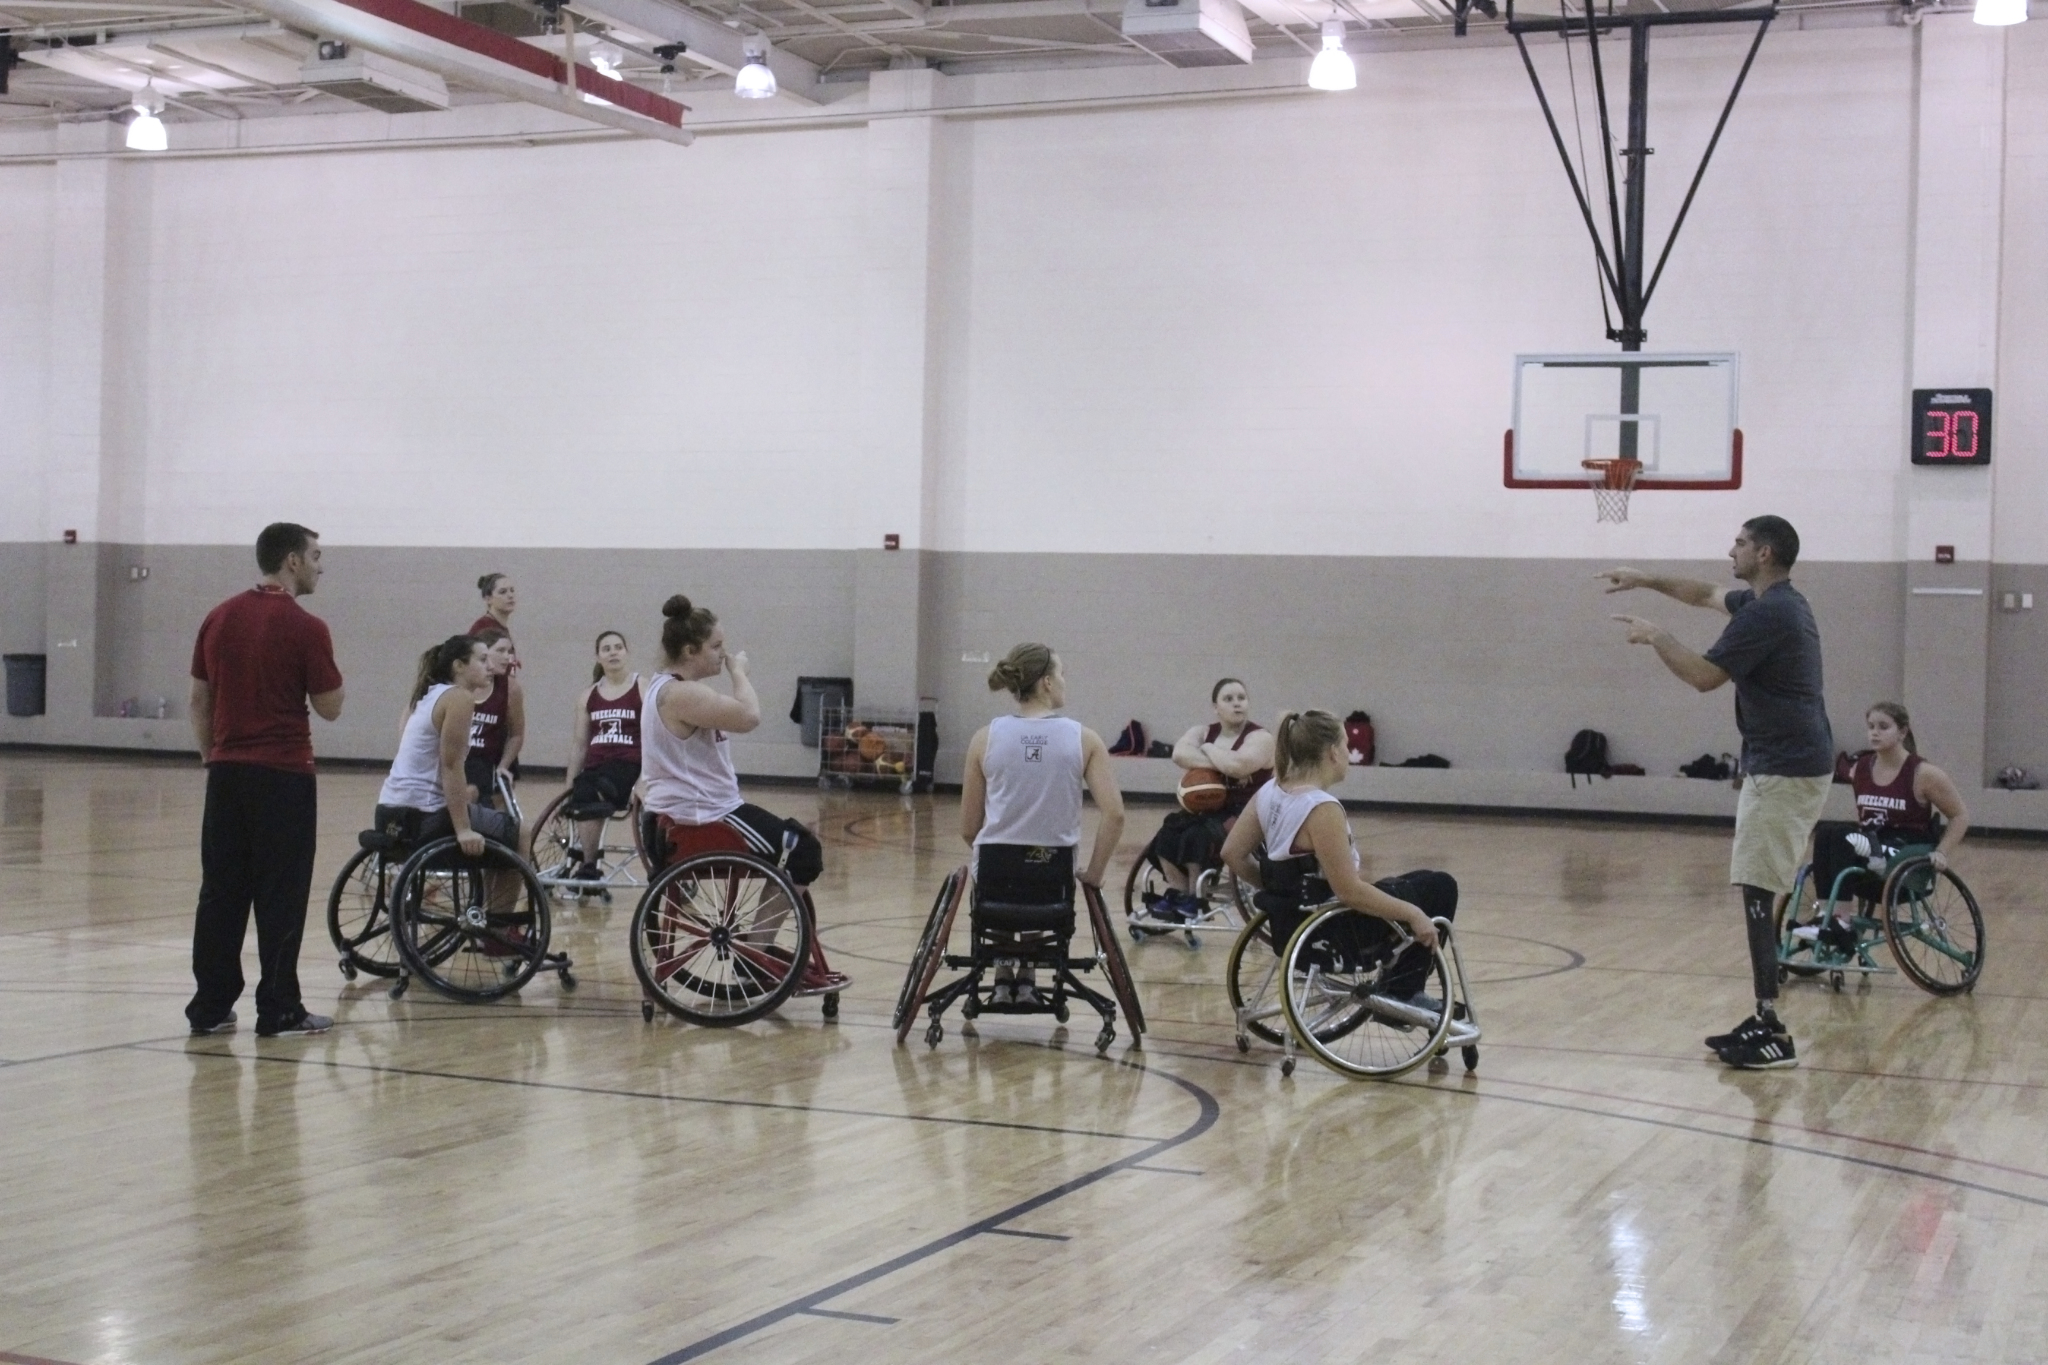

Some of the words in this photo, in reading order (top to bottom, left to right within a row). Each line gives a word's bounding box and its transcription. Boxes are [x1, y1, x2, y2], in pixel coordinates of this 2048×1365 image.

[1926, 410, 1979, 457] 30
[590, 708, 636, 721] WHEELCHAIR
[590, 734, 634, 746] SKETBALL
